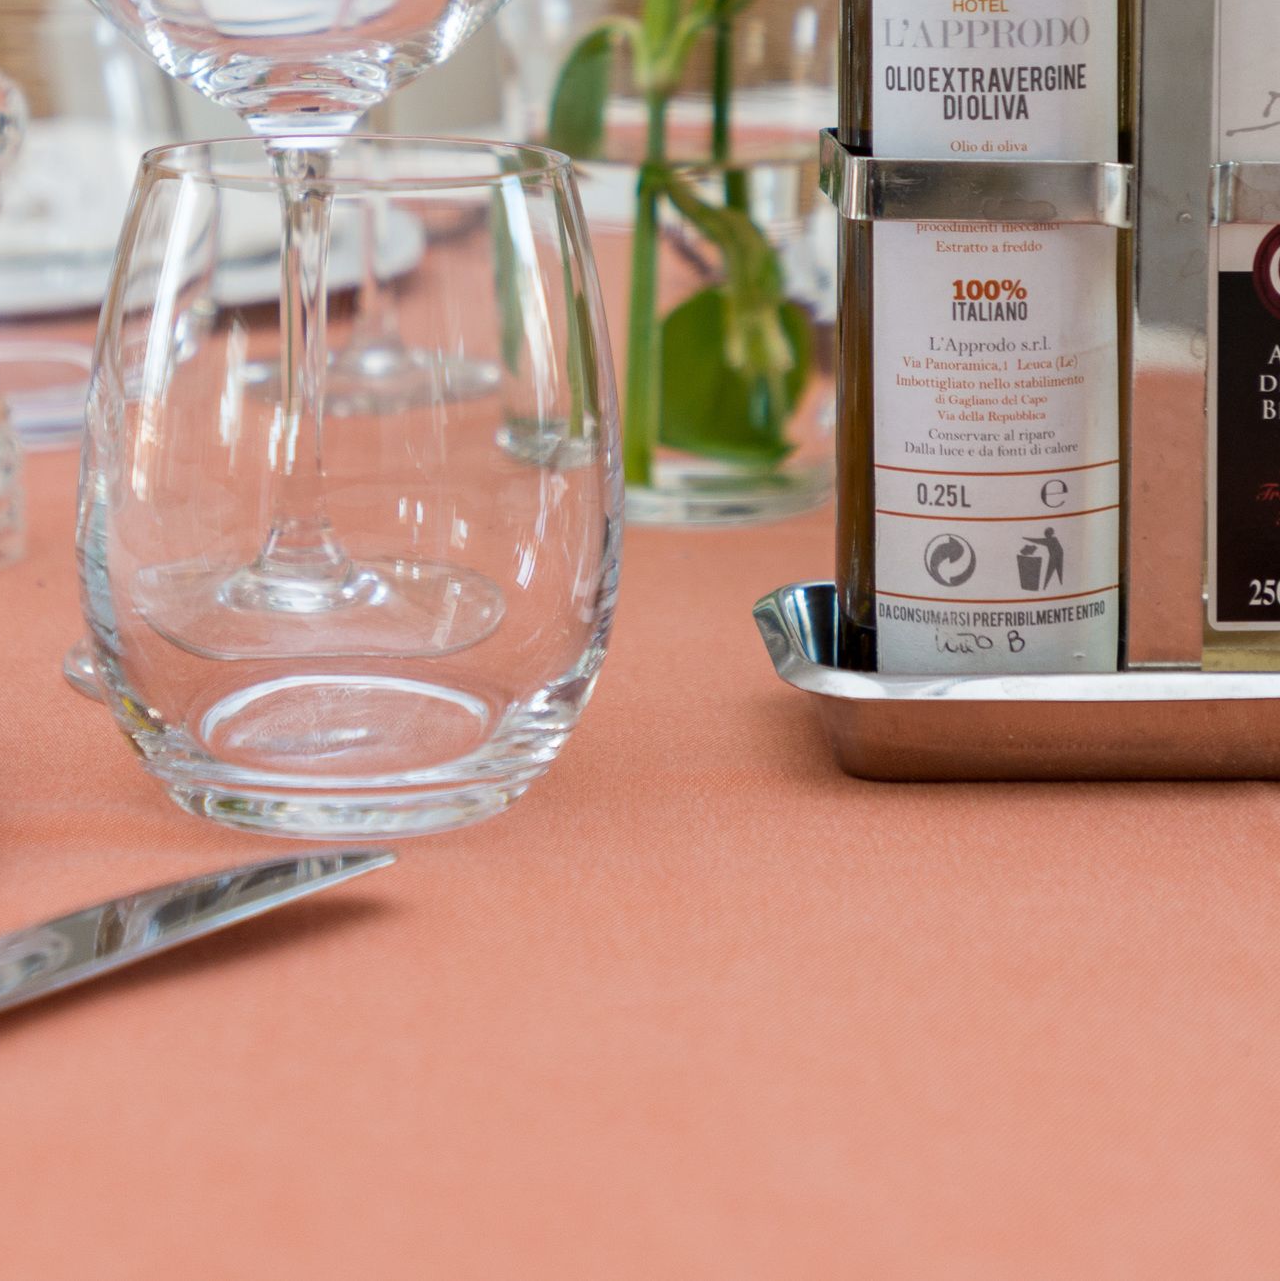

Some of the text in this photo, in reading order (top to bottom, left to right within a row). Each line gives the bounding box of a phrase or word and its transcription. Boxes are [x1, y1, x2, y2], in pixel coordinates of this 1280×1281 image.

[952, 0, 1009, 13] HOTEL
[885, 66, 925, 91] OLIO
[943, 94, 1029, 120] DI OLIVA
[950, 140, 1028, 152] Olio di oliva
[936, 241, 1043, 253] Estratto a freddo
[952, 279, 1028, 301] 100%
[952, 302, 1028, 321] ITALIANO
[929, 337, 1051, 356] L'Approdo s.r.l.
[903, 356, 921, 369] Via
[1017, 358, 1052, 371] Leuca
[896, 374, 1085, 391] Imbottigliato nello stabilimento
[935, 395, 1048, 408] di Gagliano del Capo
[937, 410, 1046, 423] Via della Repubblica
[929, 429, 1055, 443] Conservare al riparo
[905, 442, 1078, 457] Dalla luce e da fonti di calore
[893, 605, 970, 627] CONSUMARSI
[1077, 601, 1105, 619] ENTRO
